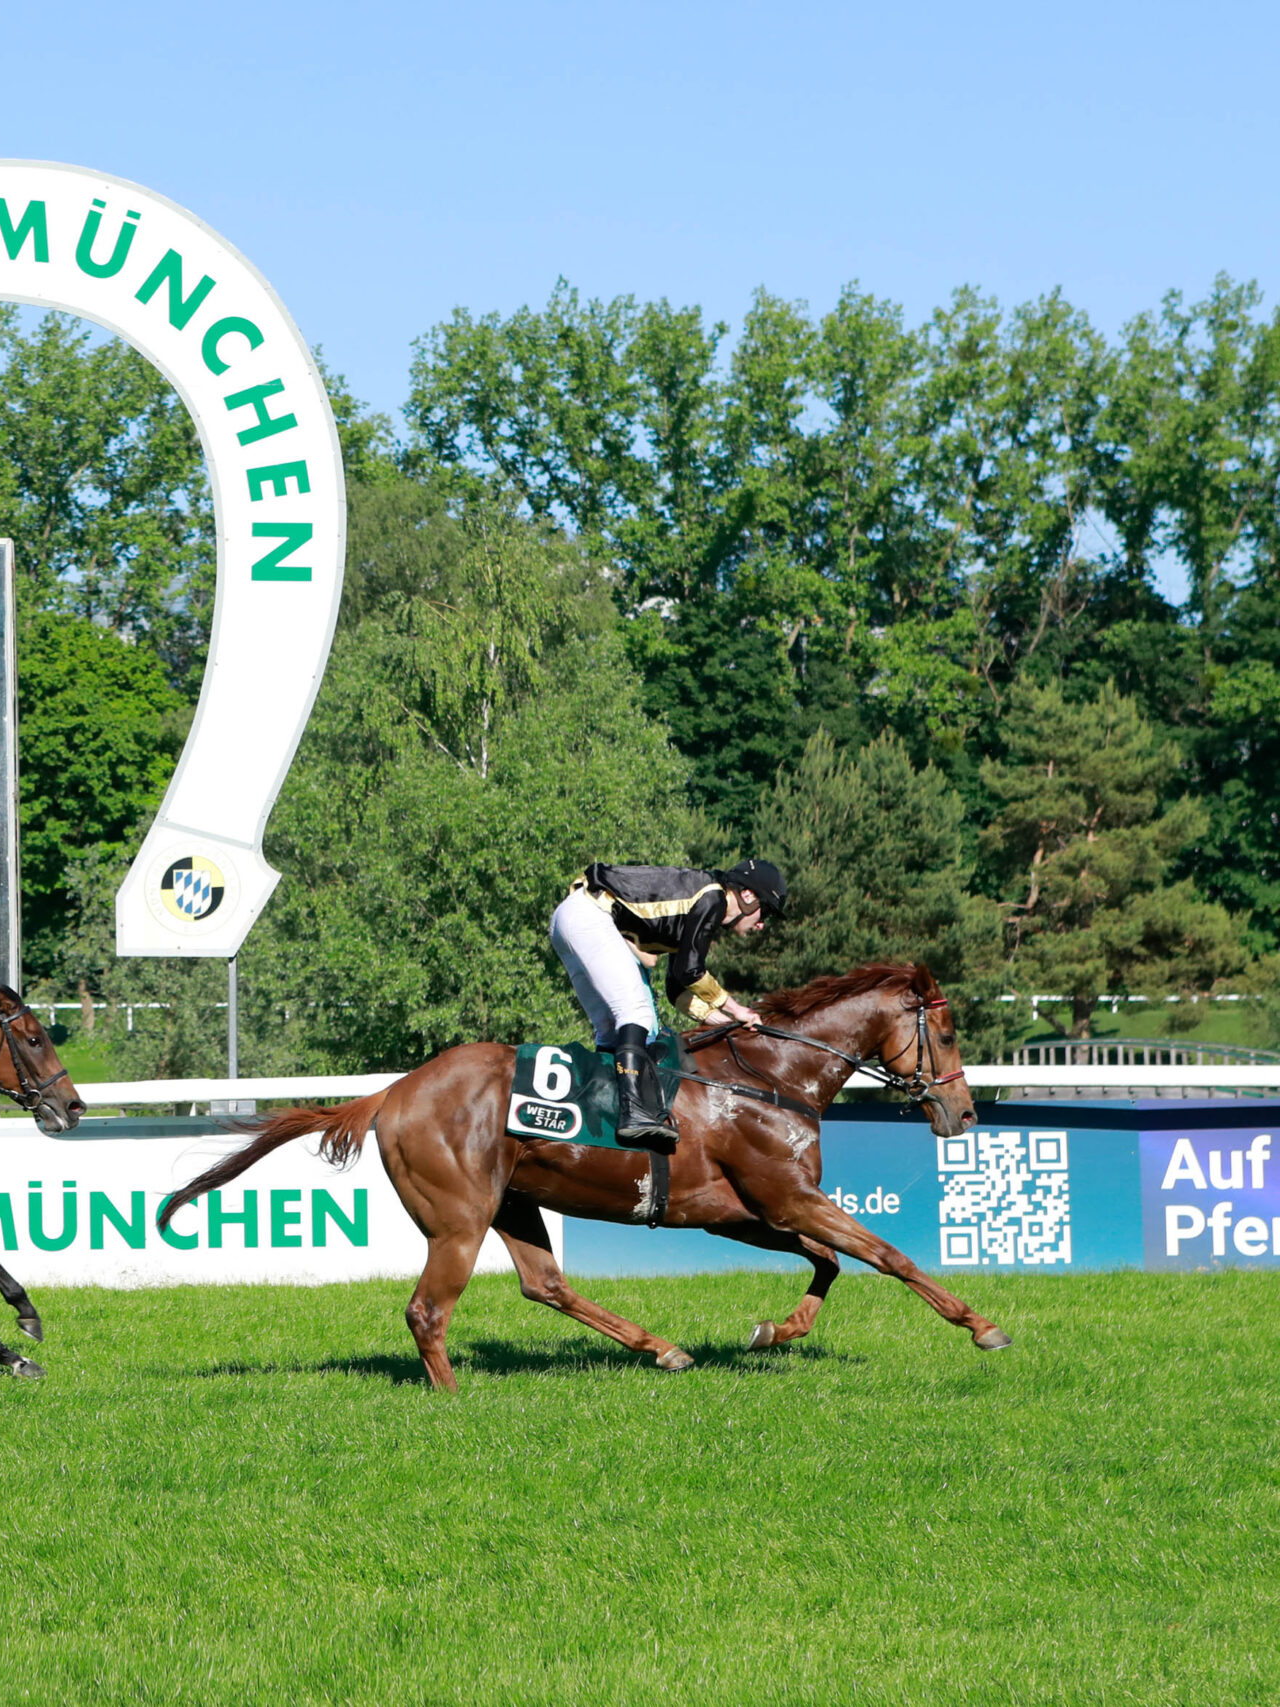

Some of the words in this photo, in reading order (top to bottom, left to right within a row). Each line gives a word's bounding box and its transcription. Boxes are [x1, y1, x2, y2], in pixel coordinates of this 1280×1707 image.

[532, 1046, 573, 1101] 6
[526, 1104, 562, 1119] WETT
[534, 1116, 567, 1130] STAR
[1161, 1134, 1271, 1190] Auf
